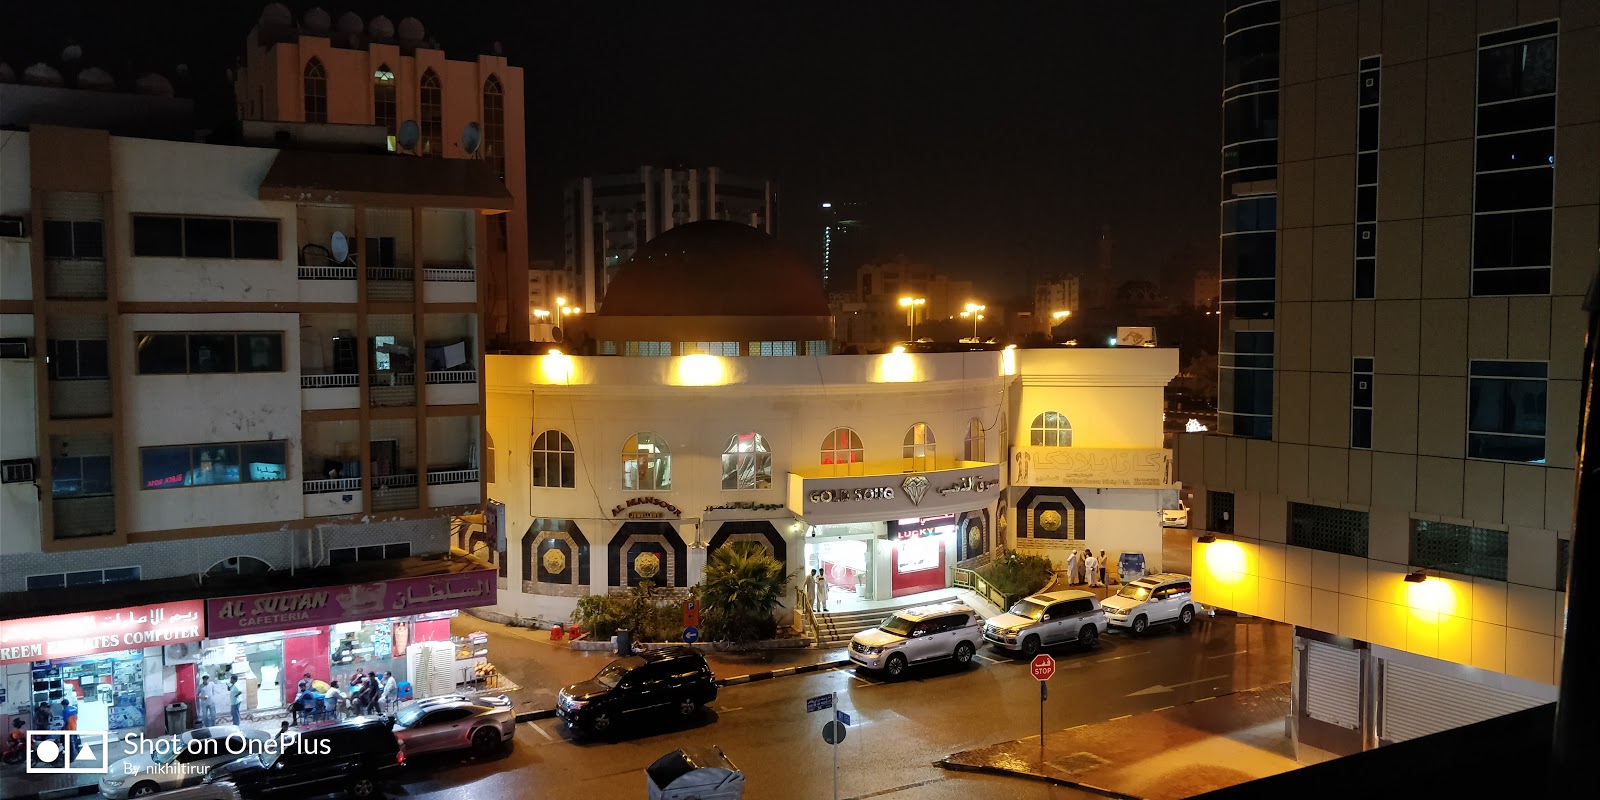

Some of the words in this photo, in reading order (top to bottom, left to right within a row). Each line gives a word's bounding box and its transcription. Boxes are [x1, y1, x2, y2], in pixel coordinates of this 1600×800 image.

[936, 476, 974, 496] الذهب
[974, 476, 999, 493] سوق
[809, 489, 850, 503] GOLD
[854, 486, 895, 502] SOUQ
[611, 504, 625, 517] AL
[626, 496, 682, 517] MANSOOR
[897, 527, 934, 539] LUCKY
[392, 578, 490, 610] السلطان
[218, 600, 247, 620] AL
[250, 591, 329, 615] SULTAN
[688, 602, 694, 610] P
[170, 611, 198, 624] ريم
[238, 612, 310, 627] CAFETERIA
[0, 644, 42, 660] REEM
[47, 634, 119, 655] EATES
[124, 625, 200, 646] COMPUTER
[1035, 657, 1051, 667] قف
[1034, 667, 1052, 675] STOP
